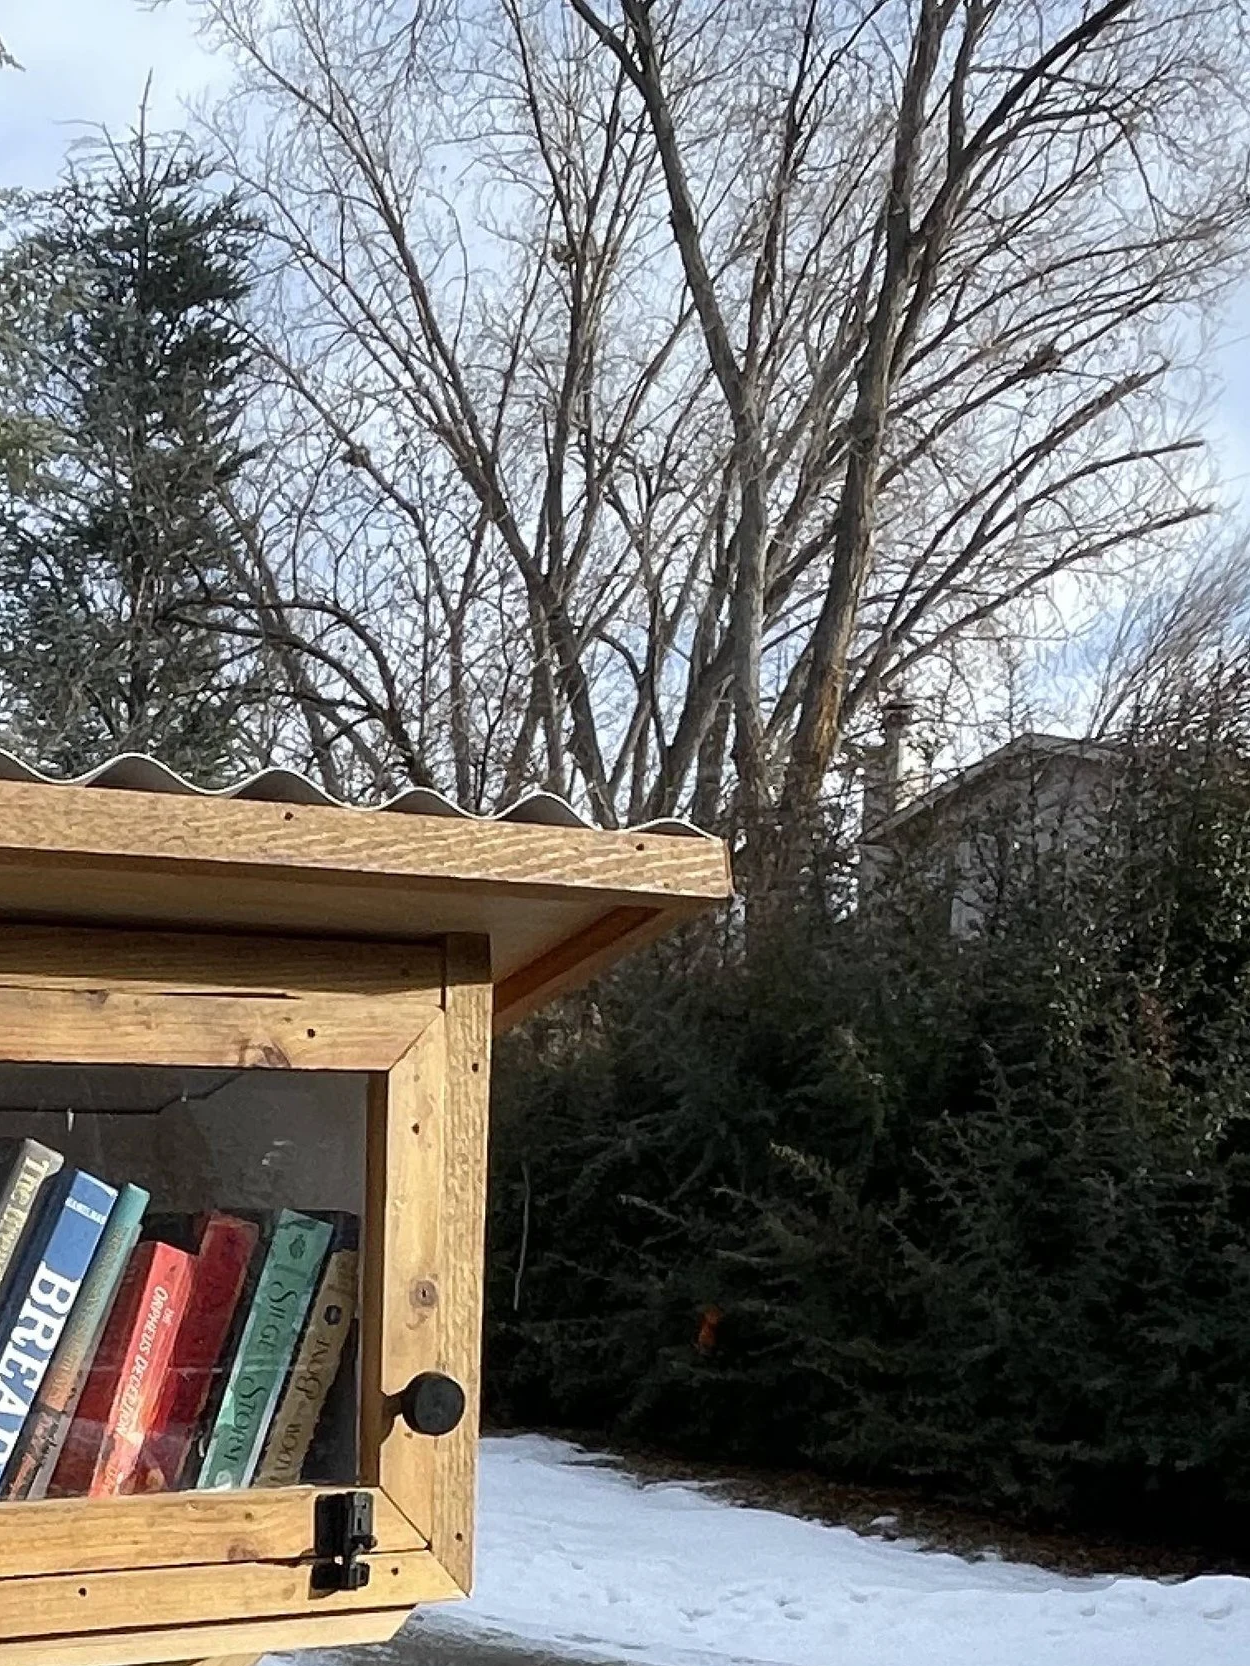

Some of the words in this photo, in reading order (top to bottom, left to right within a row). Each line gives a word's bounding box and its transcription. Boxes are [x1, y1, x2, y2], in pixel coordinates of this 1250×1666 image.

[139, 1286, 169, 1355] ORPHEUS
[115, 1354, 149, 1437] DECEPTION
[223, 1376, 267, 1461] STORM
